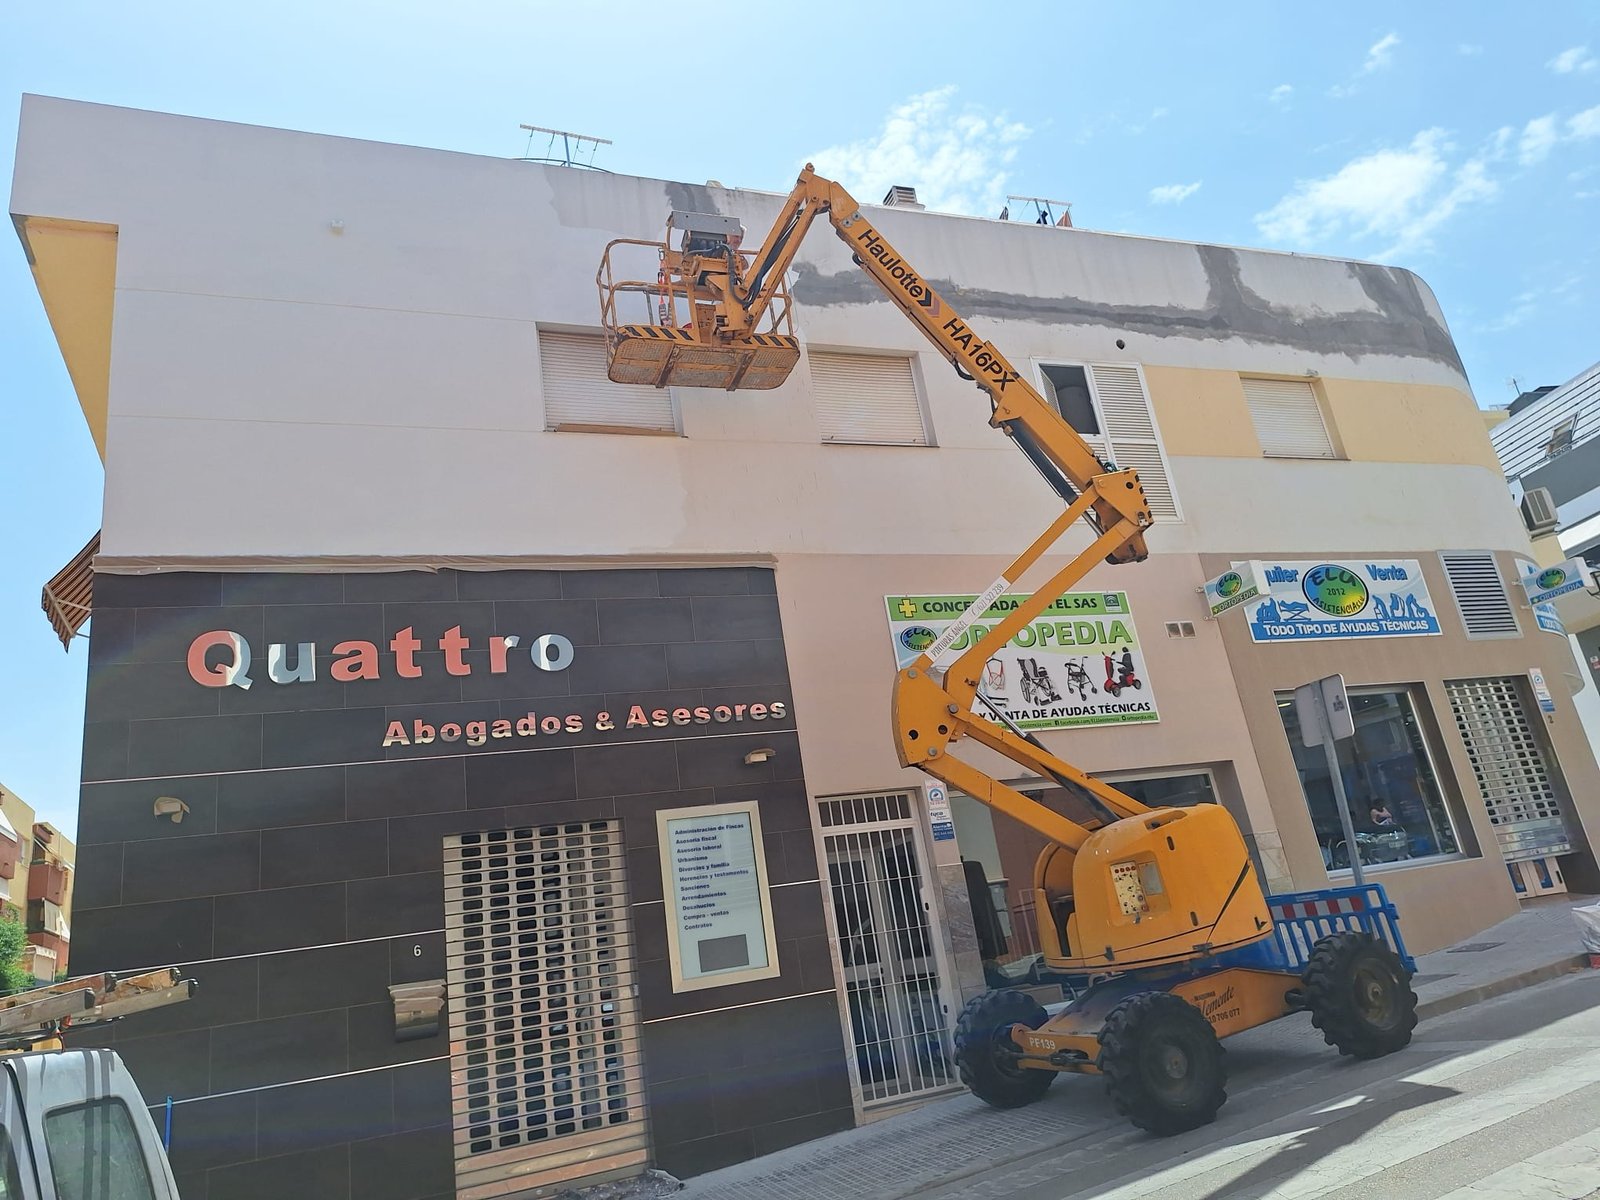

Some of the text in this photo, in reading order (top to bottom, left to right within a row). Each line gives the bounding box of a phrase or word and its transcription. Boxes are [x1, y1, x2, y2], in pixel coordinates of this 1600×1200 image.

[857, 229, 1015, 392] Haulotte HA16PX
[1365, 564, 1408, 581] Venta
[1326, 588, 1346, 596] 2012
[1539, 581, 1581, 601] ORTOPEDIA
[922, 600, 1020, 613] CONCEADA
[1056, 599, 1071, 609] EL
[1074, 598, 1097, 609] SAS
[1219, 589, 1256, 611] ORTOPEDIA
[942, 619, 1133, 651] OROPEDIA
[1264, 619, 1429, 636] TODO TIPO DE AYUDAS TÉCNICAS
[931, 632, 954, 658] PINTURAS
[186, 624, 575, 690] Quattro
[1032, 709, 1048, 718] DE
[1051, 706, 1096, 717] AYUDAS
[1098, 702, 1151, 714] TÉCNICAS
[382, 700, 787, 747] Abogados & Asesores
[714, 869, 749, 877] testamentos
[681, 892, 727, 901] Arrendamientos
[683, 902, 715, 910] Desahucios
[684, 922, 712, 930] Contratos
[413, 944, 422, 957] 6
